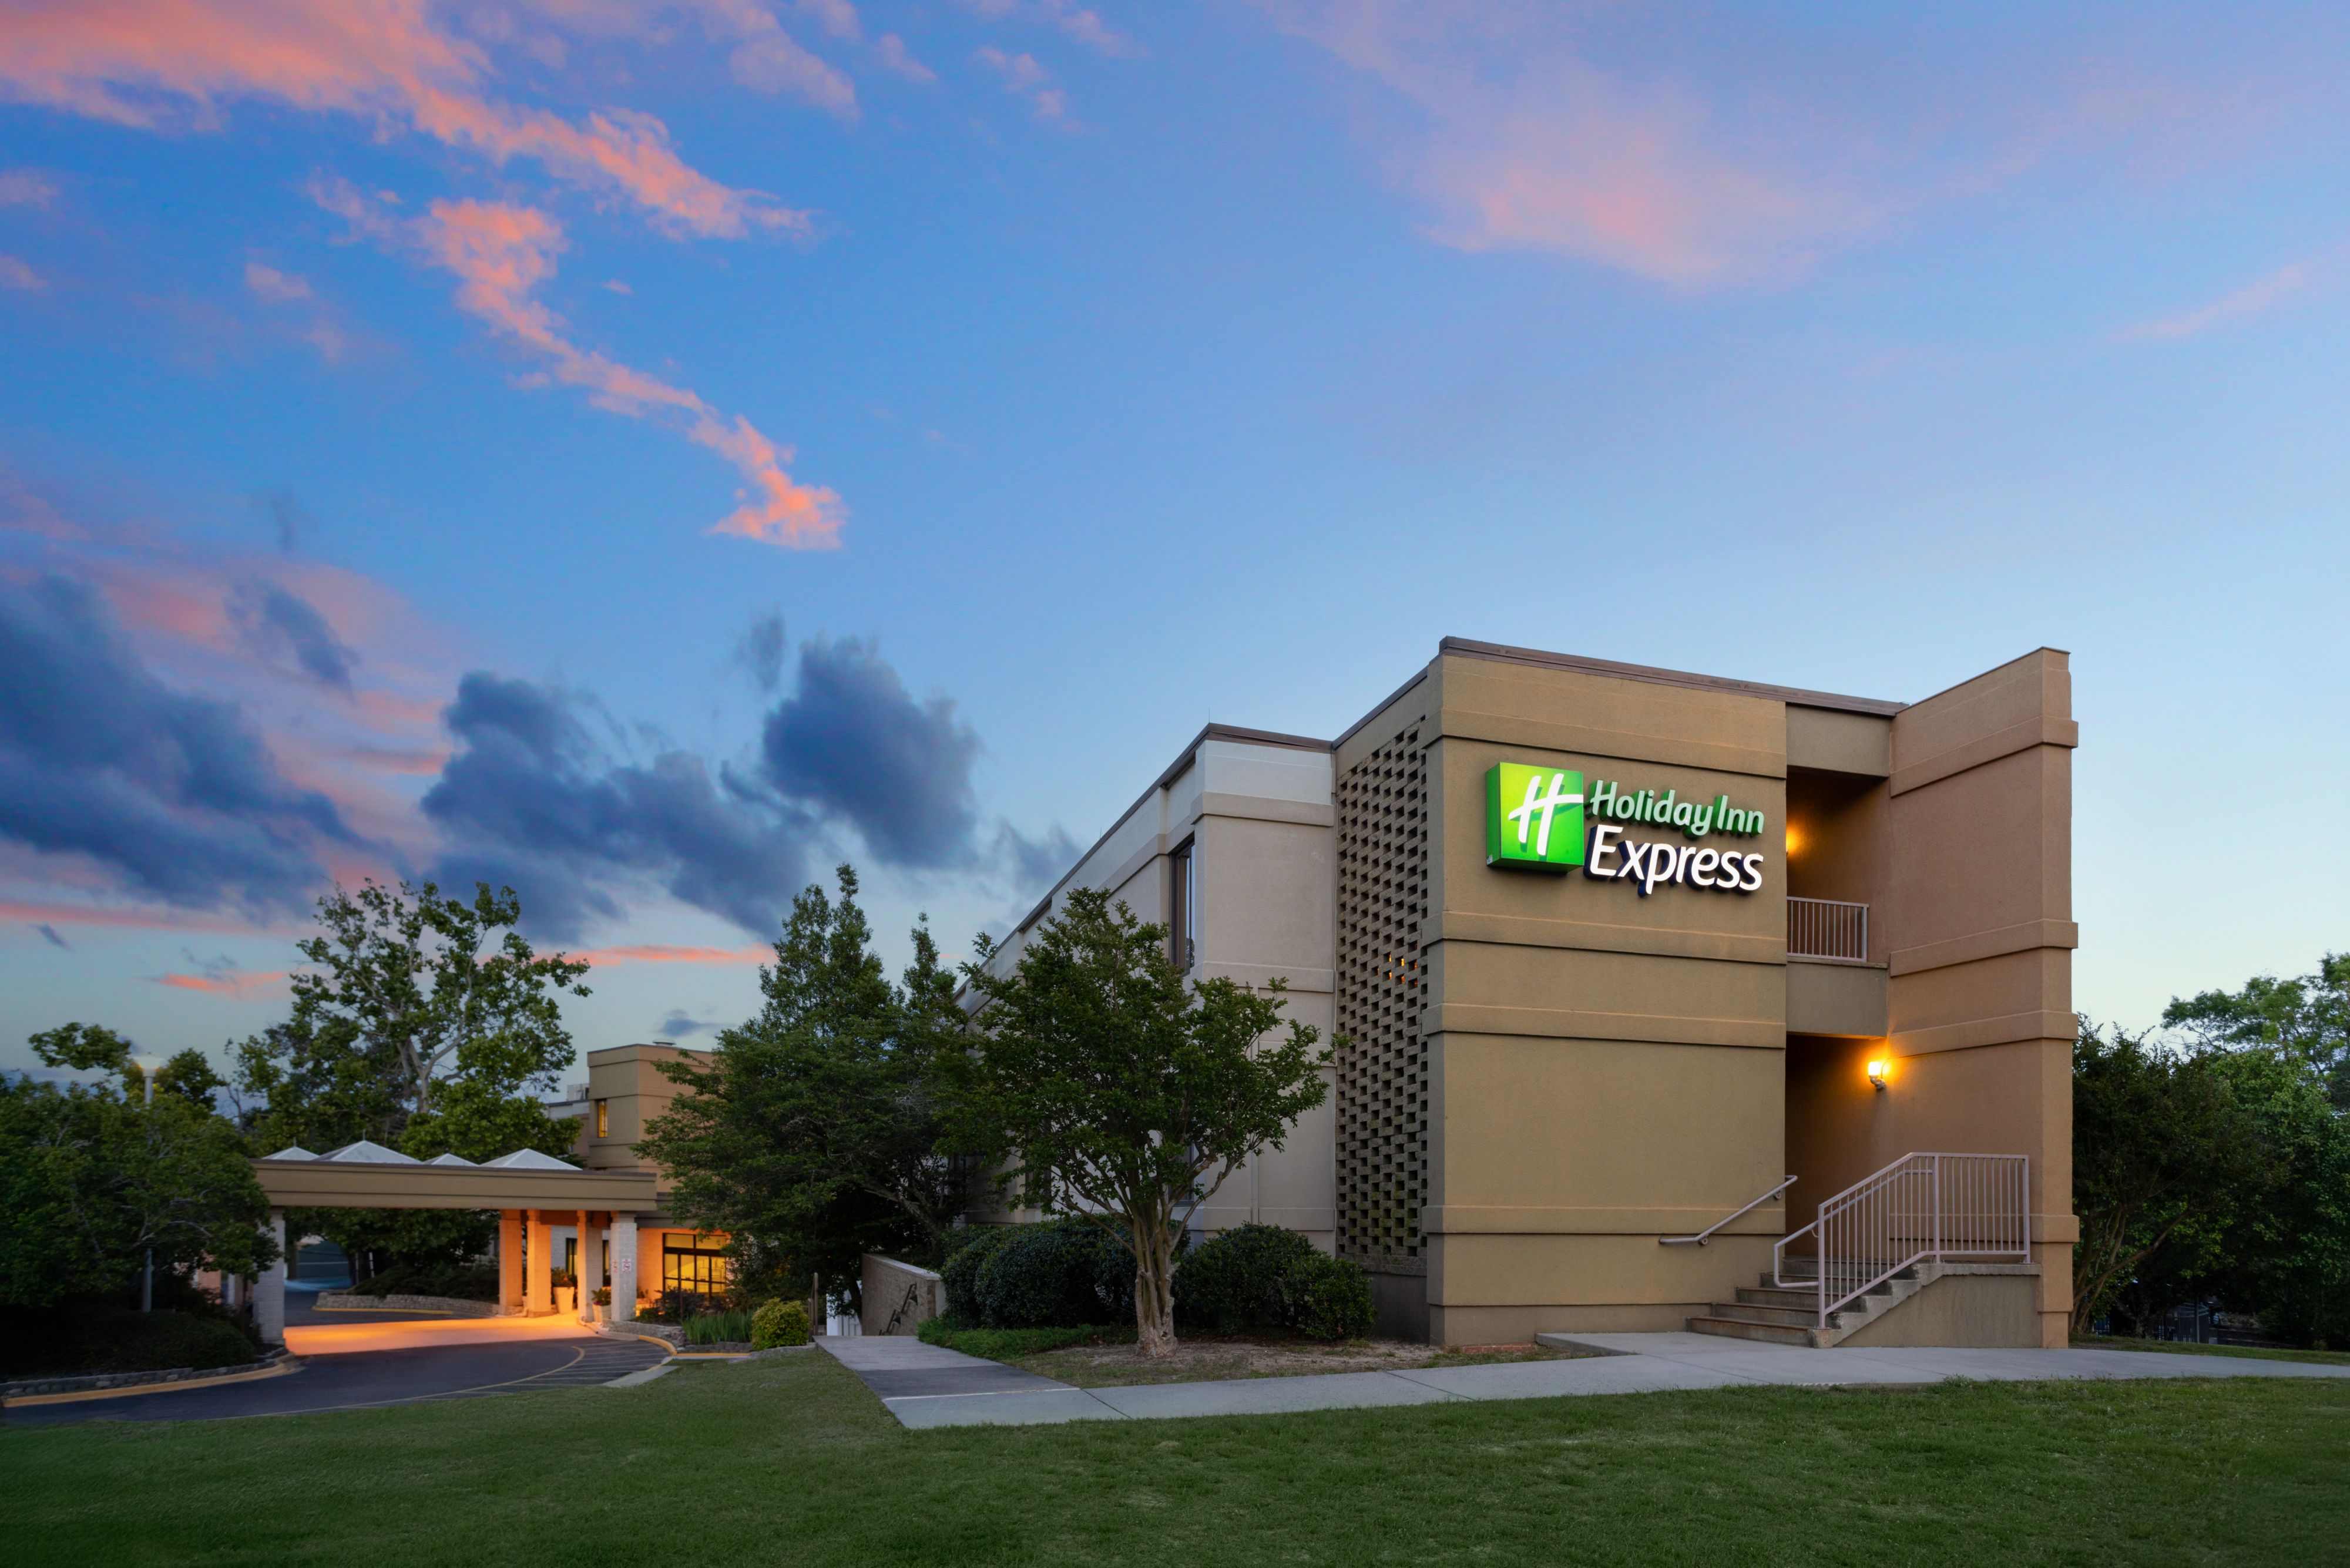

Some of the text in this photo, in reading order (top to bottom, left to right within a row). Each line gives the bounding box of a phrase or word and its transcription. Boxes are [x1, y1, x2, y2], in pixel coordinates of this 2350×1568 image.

[1590, 780, 1764, 836] Holiday Inn
[1590, 824, 1764, 895] Express
